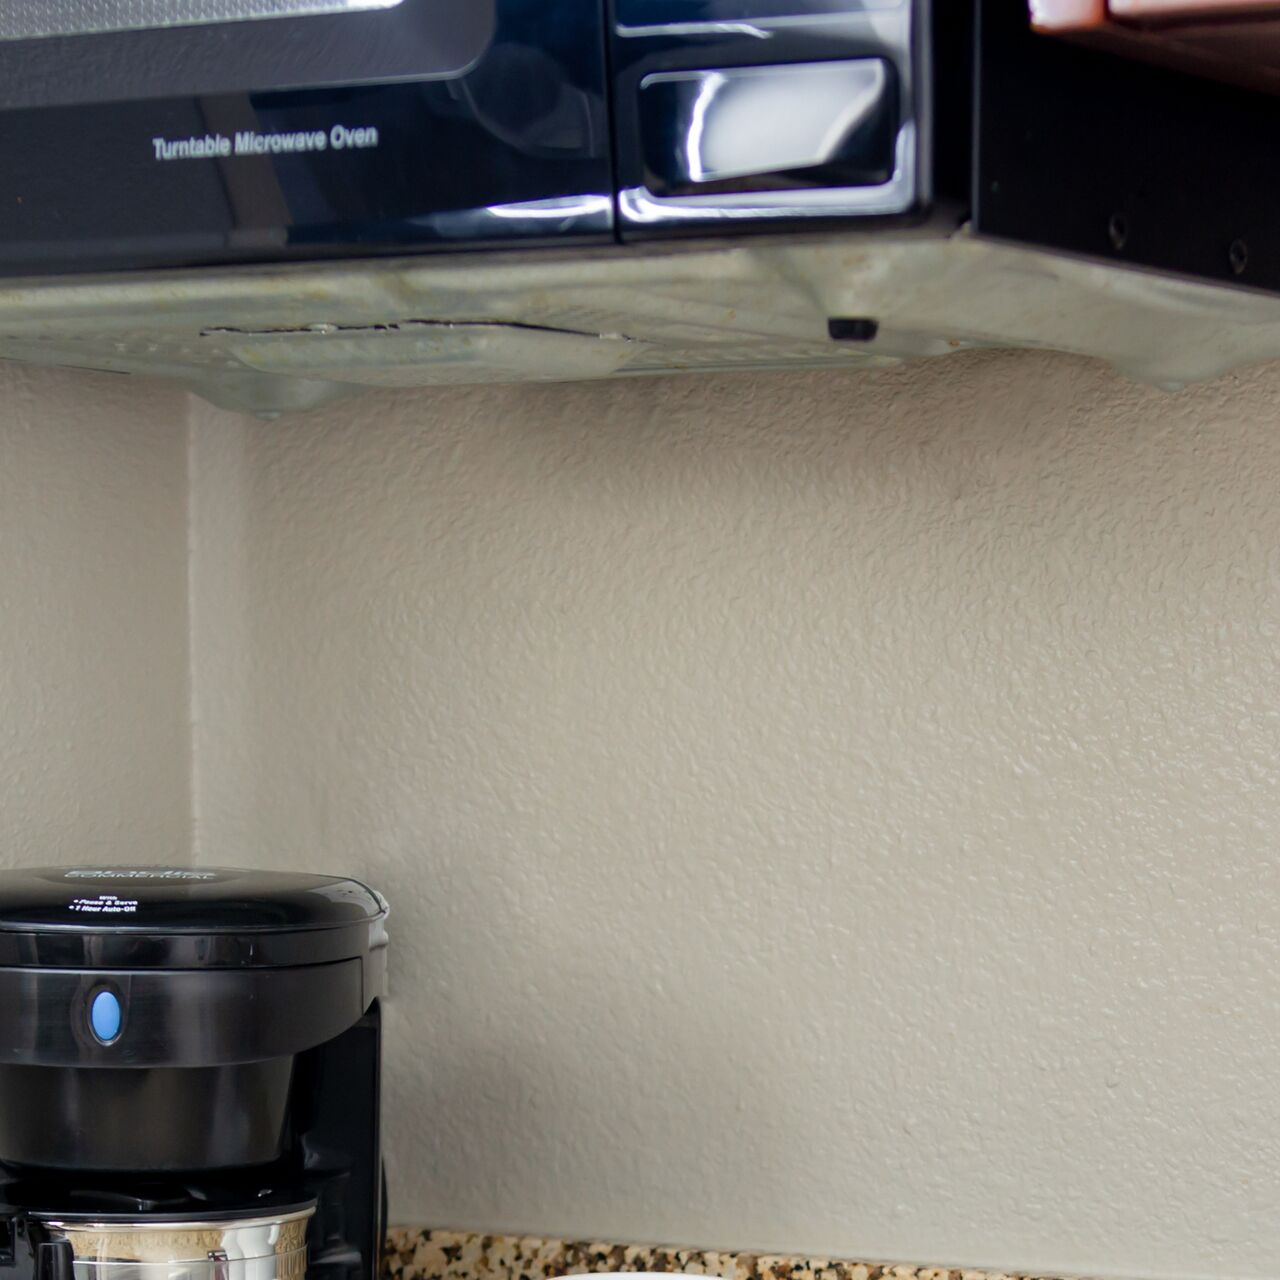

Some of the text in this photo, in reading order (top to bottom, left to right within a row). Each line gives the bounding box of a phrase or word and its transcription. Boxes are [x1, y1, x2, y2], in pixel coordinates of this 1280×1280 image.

[152, 124, 379, 160] Turntable Microwave Oven
